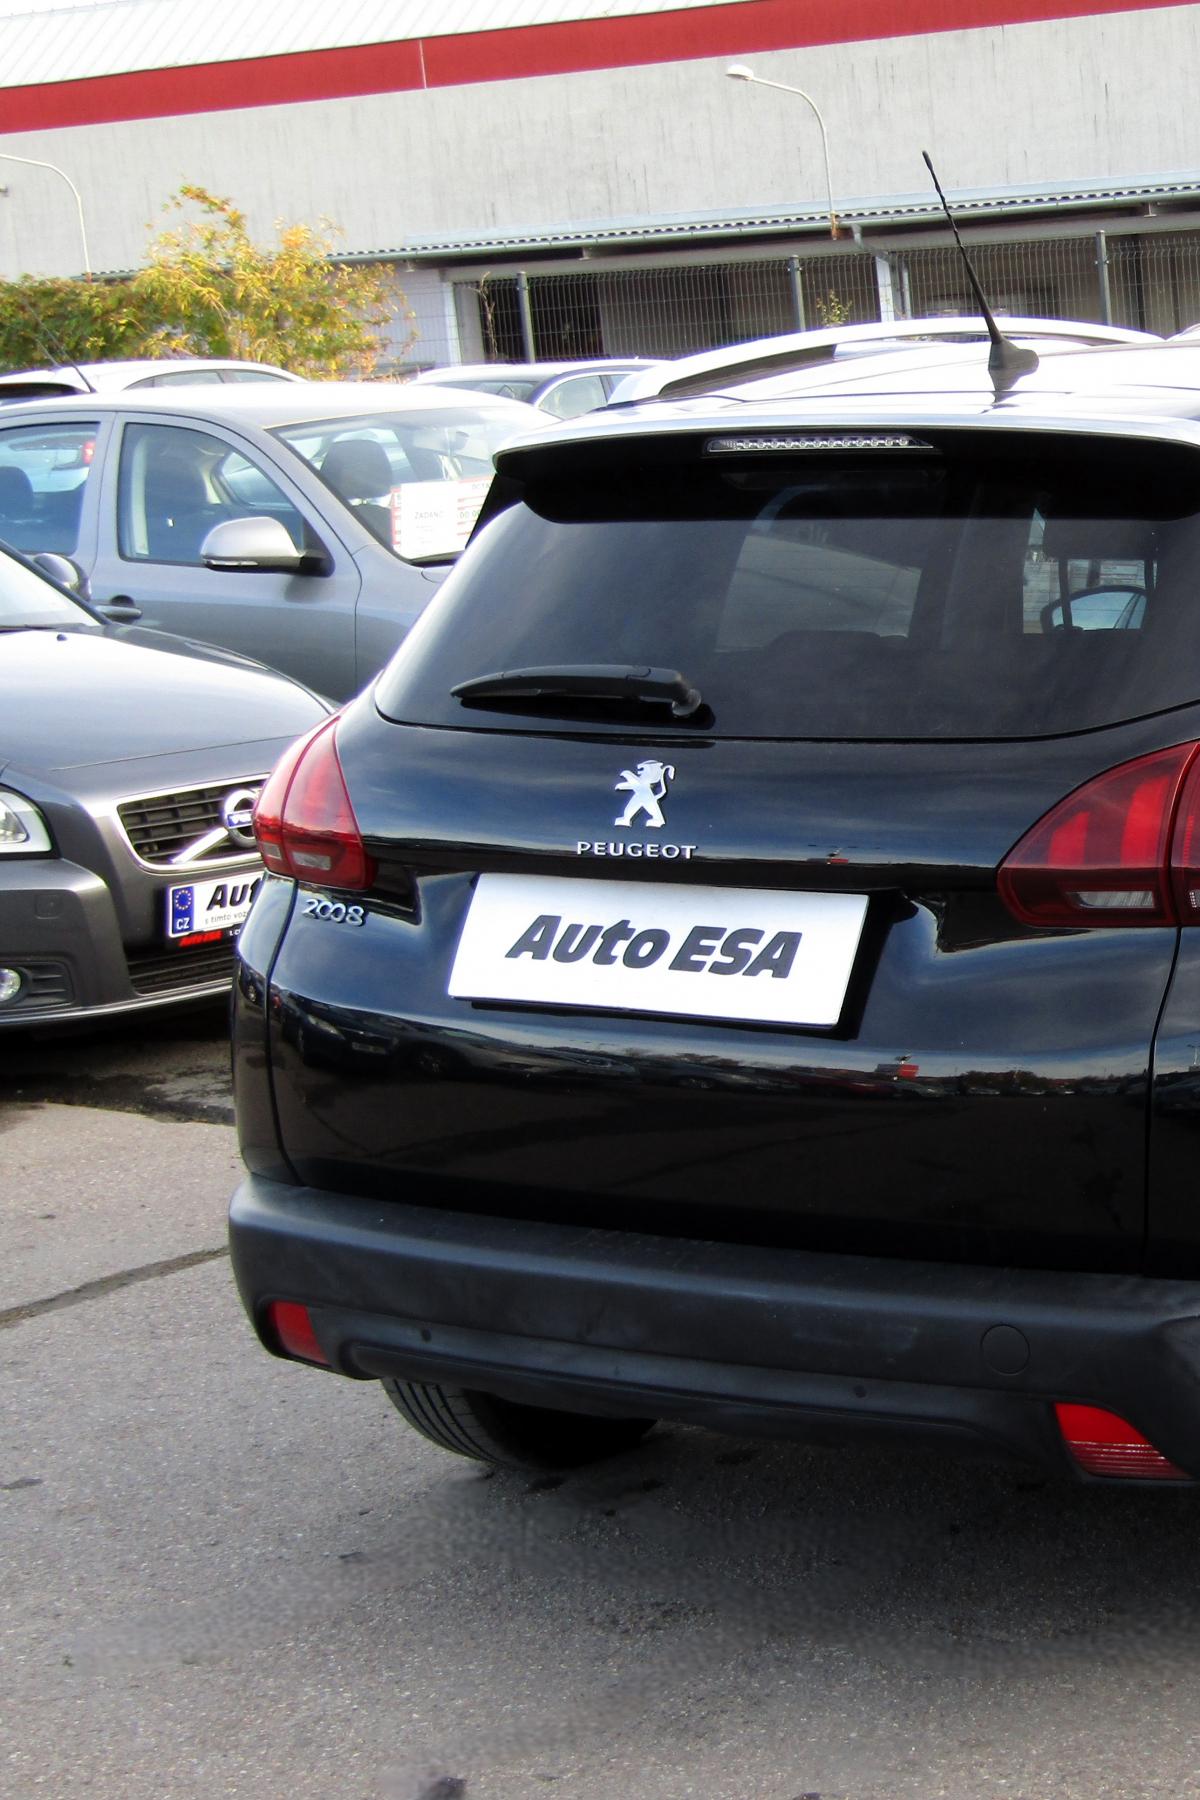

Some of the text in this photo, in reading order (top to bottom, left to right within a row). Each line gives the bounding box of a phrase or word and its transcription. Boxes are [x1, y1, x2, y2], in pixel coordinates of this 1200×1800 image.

[577, 841, 696, 860] PEUGEOT
[176, 917, 190, 930] CZ
[302, 899, 365, 926] 2008
[504, 914, 803, 979] Auto ESA
